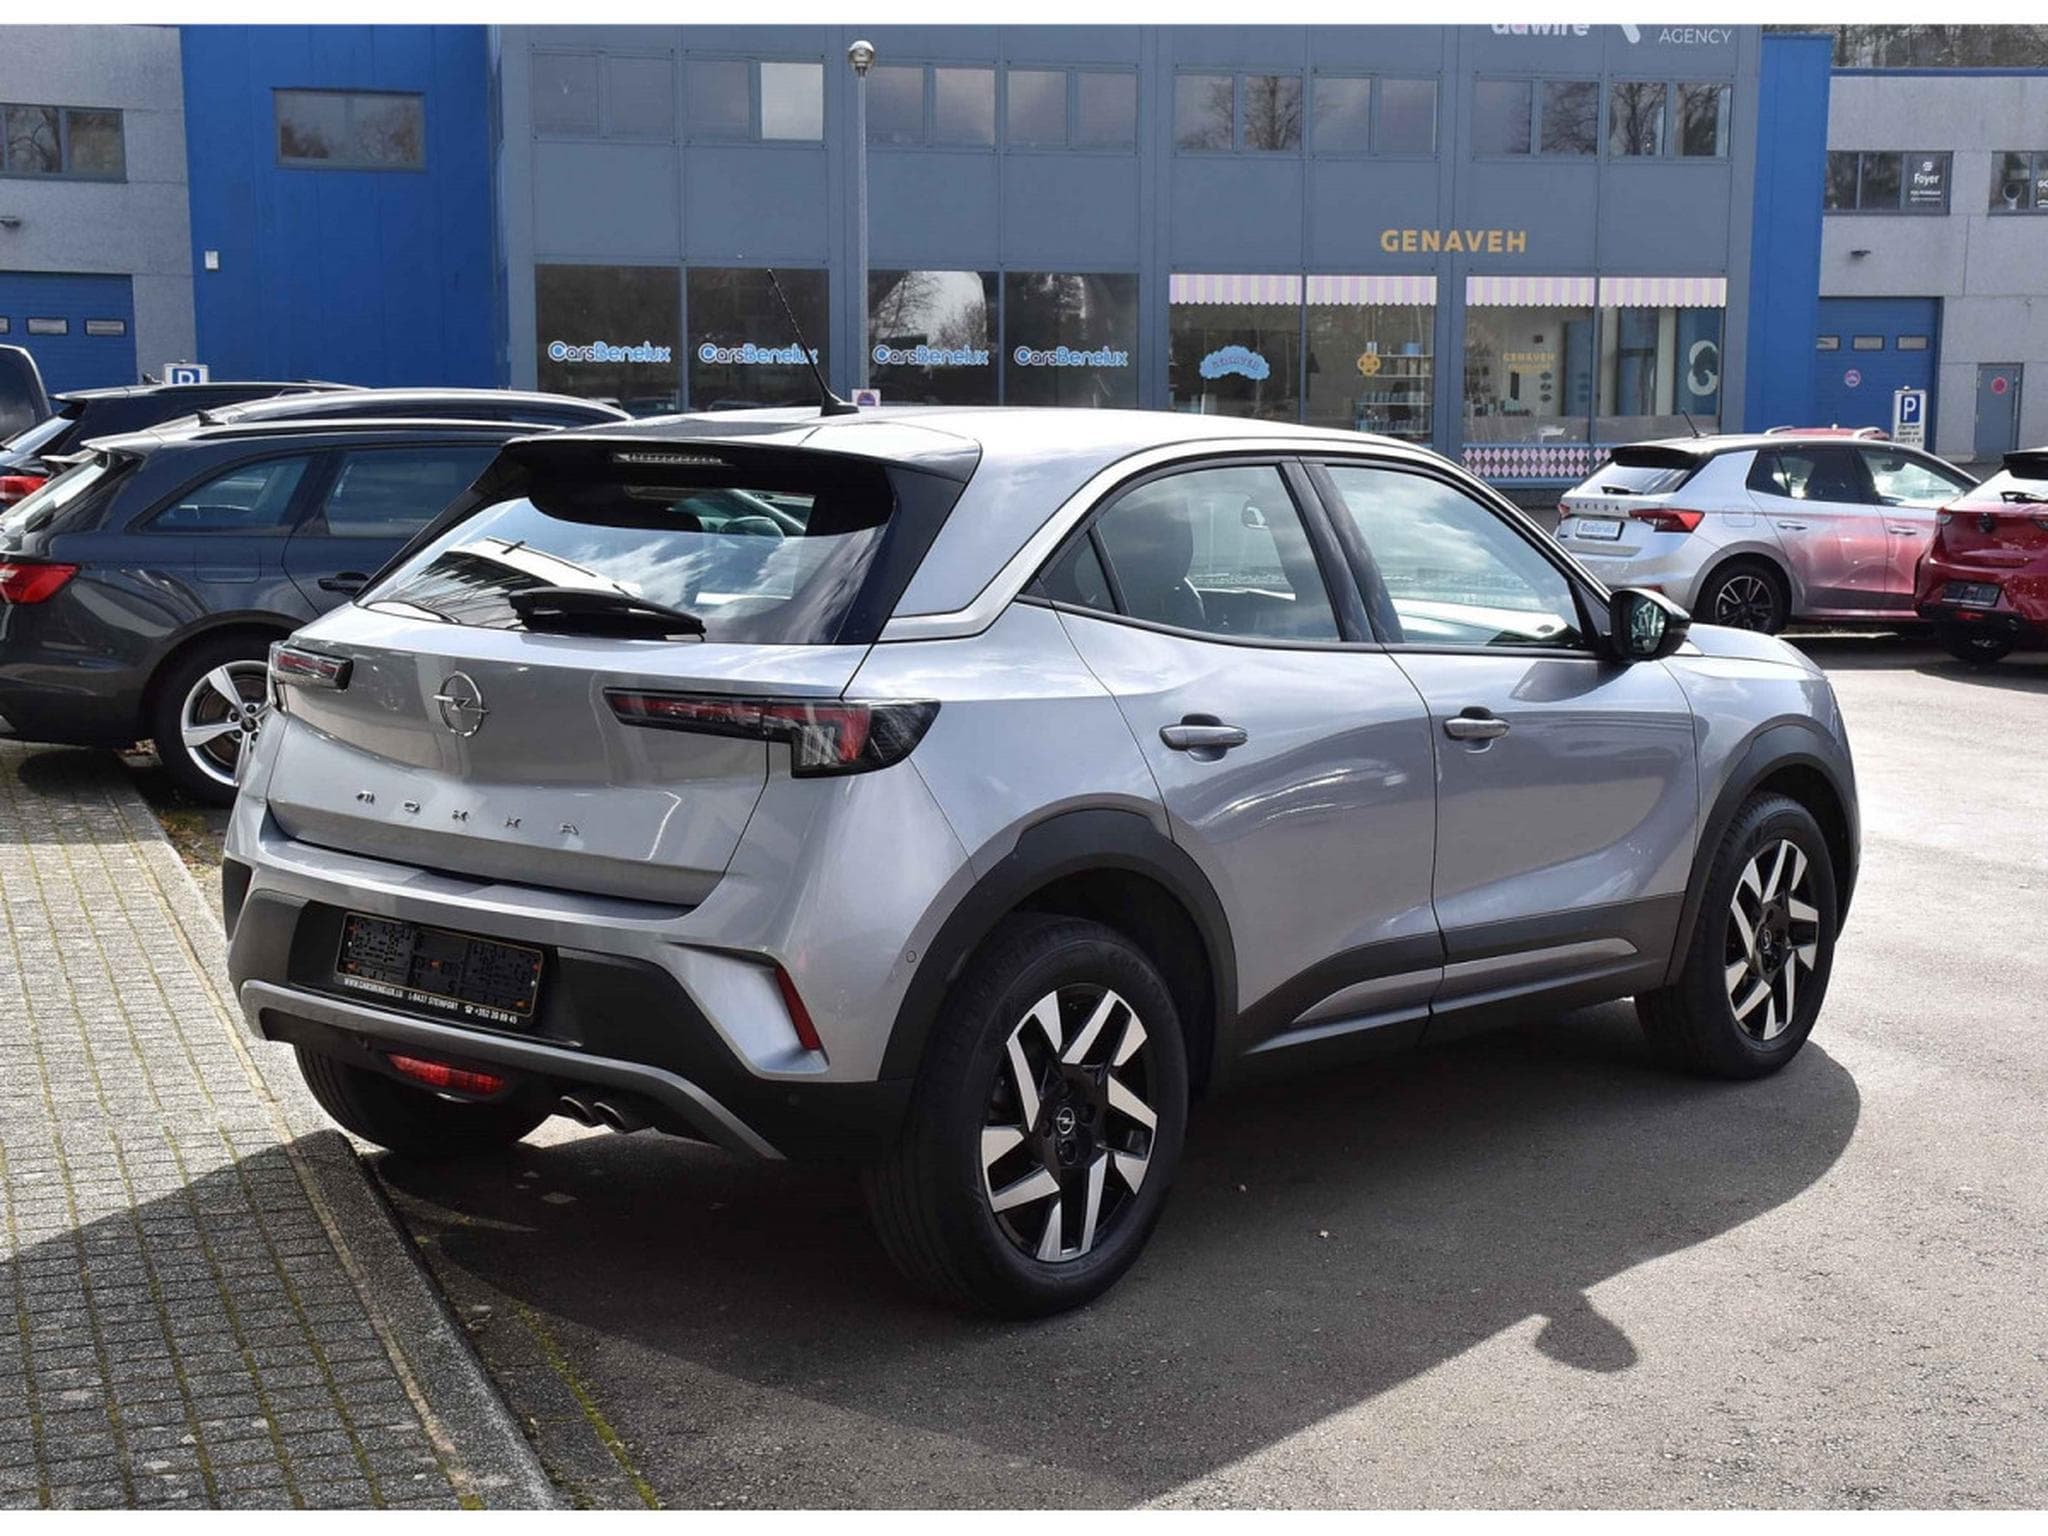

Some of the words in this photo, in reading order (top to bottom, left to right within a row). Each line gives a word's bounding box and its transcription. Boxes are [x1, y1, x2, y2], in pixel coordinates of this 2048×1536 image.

[1658, 28, 1732, 44] AGENCY
[1914, 173, 1940, 186] Foyer
[1380, 229, 1527, 253] GENAVEH
[548, 341, 671, 363] CarsBenelux
[698, 343, 819, 365] CarsBenelux
[872, 344, 990, 366] CarsBenelux
[1013, 345, 1129, 367] CarsBenelux
[1904, 397, 1916, 420] P
